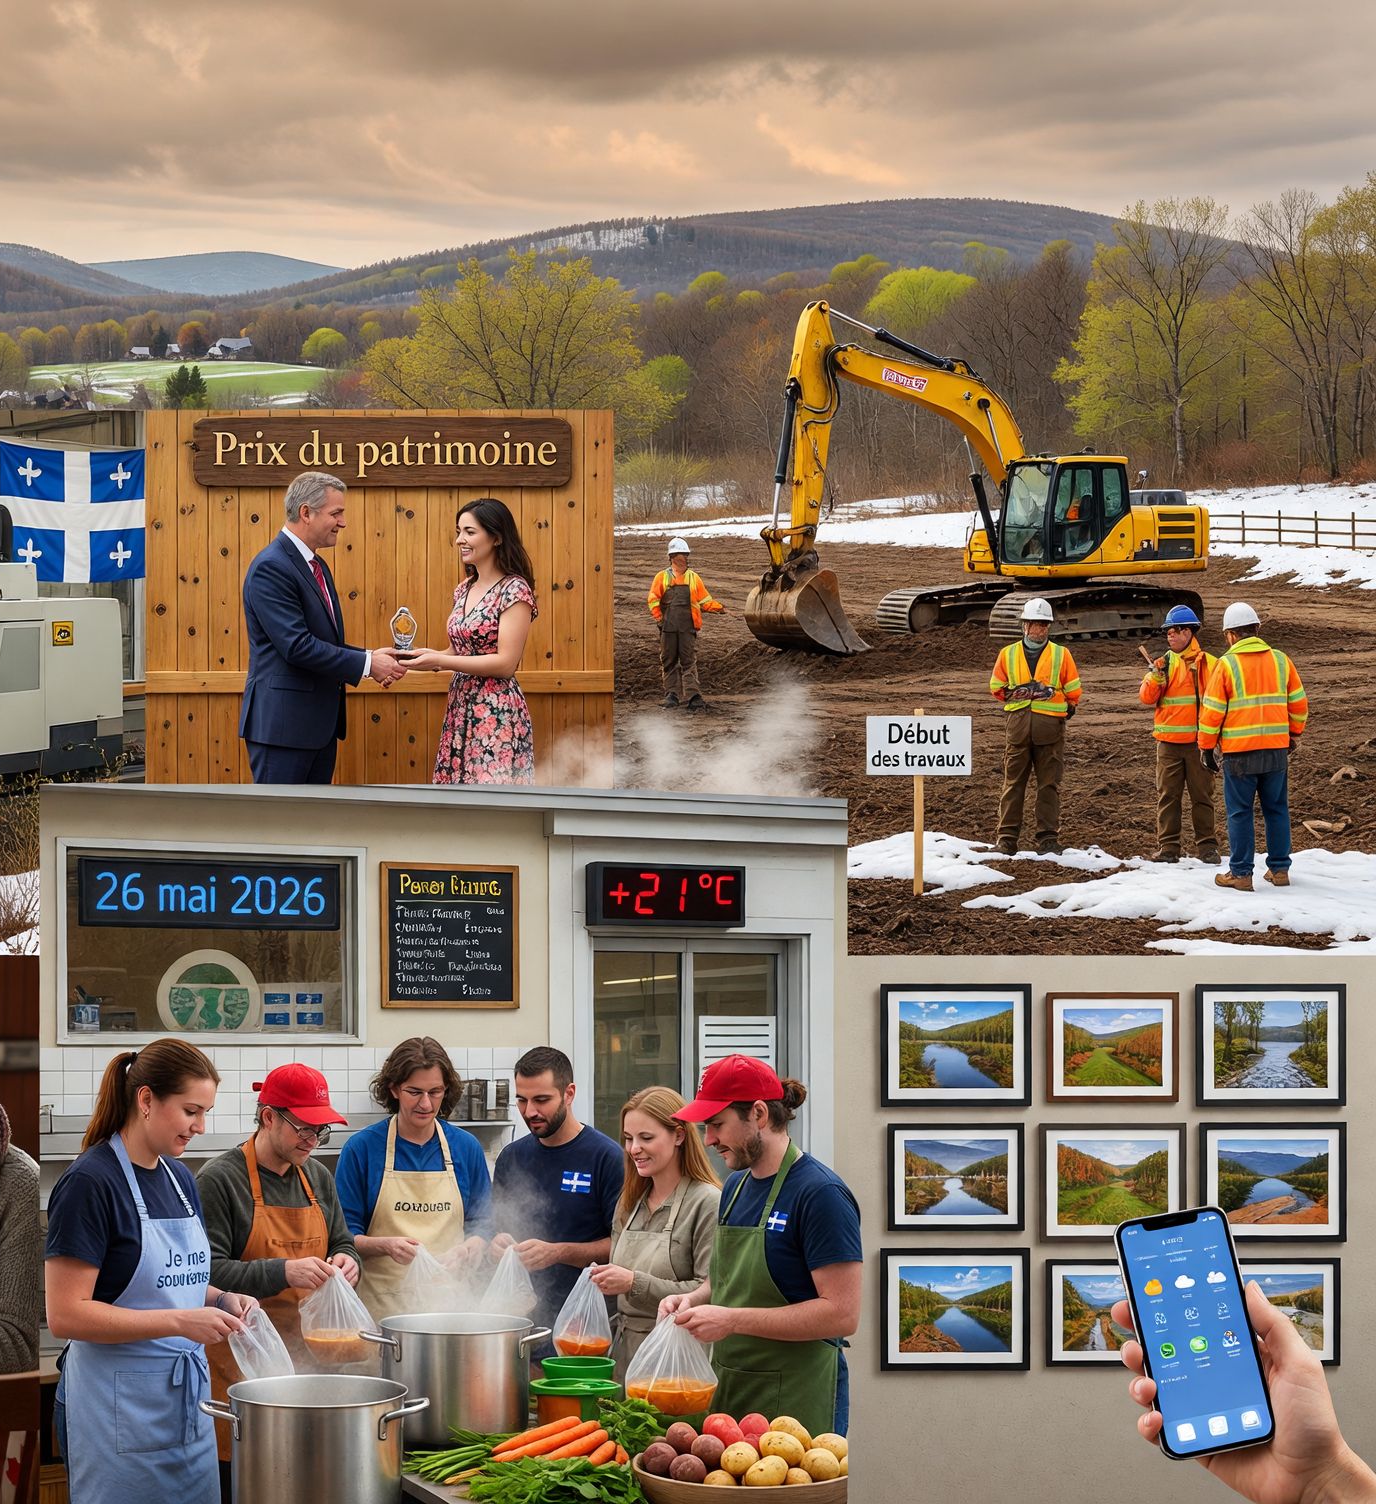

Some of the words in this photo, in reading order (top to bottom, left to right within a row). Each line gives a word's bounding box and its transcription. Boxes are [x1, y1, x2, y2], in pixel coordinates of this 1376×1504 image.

[212, 431, 288, 466] Prix
[299, 430, 345, 466] du
[356, 431, 557, 477] patrimoine
[888, 723, 950, 744] Début
[872, 750, 899, 767] des
[905, 751, 965, 767] travaux
[96, 872, 144, 911] 26
[159, 876, 216, 913] mai
[231, 875, 325, 916] 2026
[166, 1249, 182, 1268] Je
[188, 1251, 205, 1265] me
